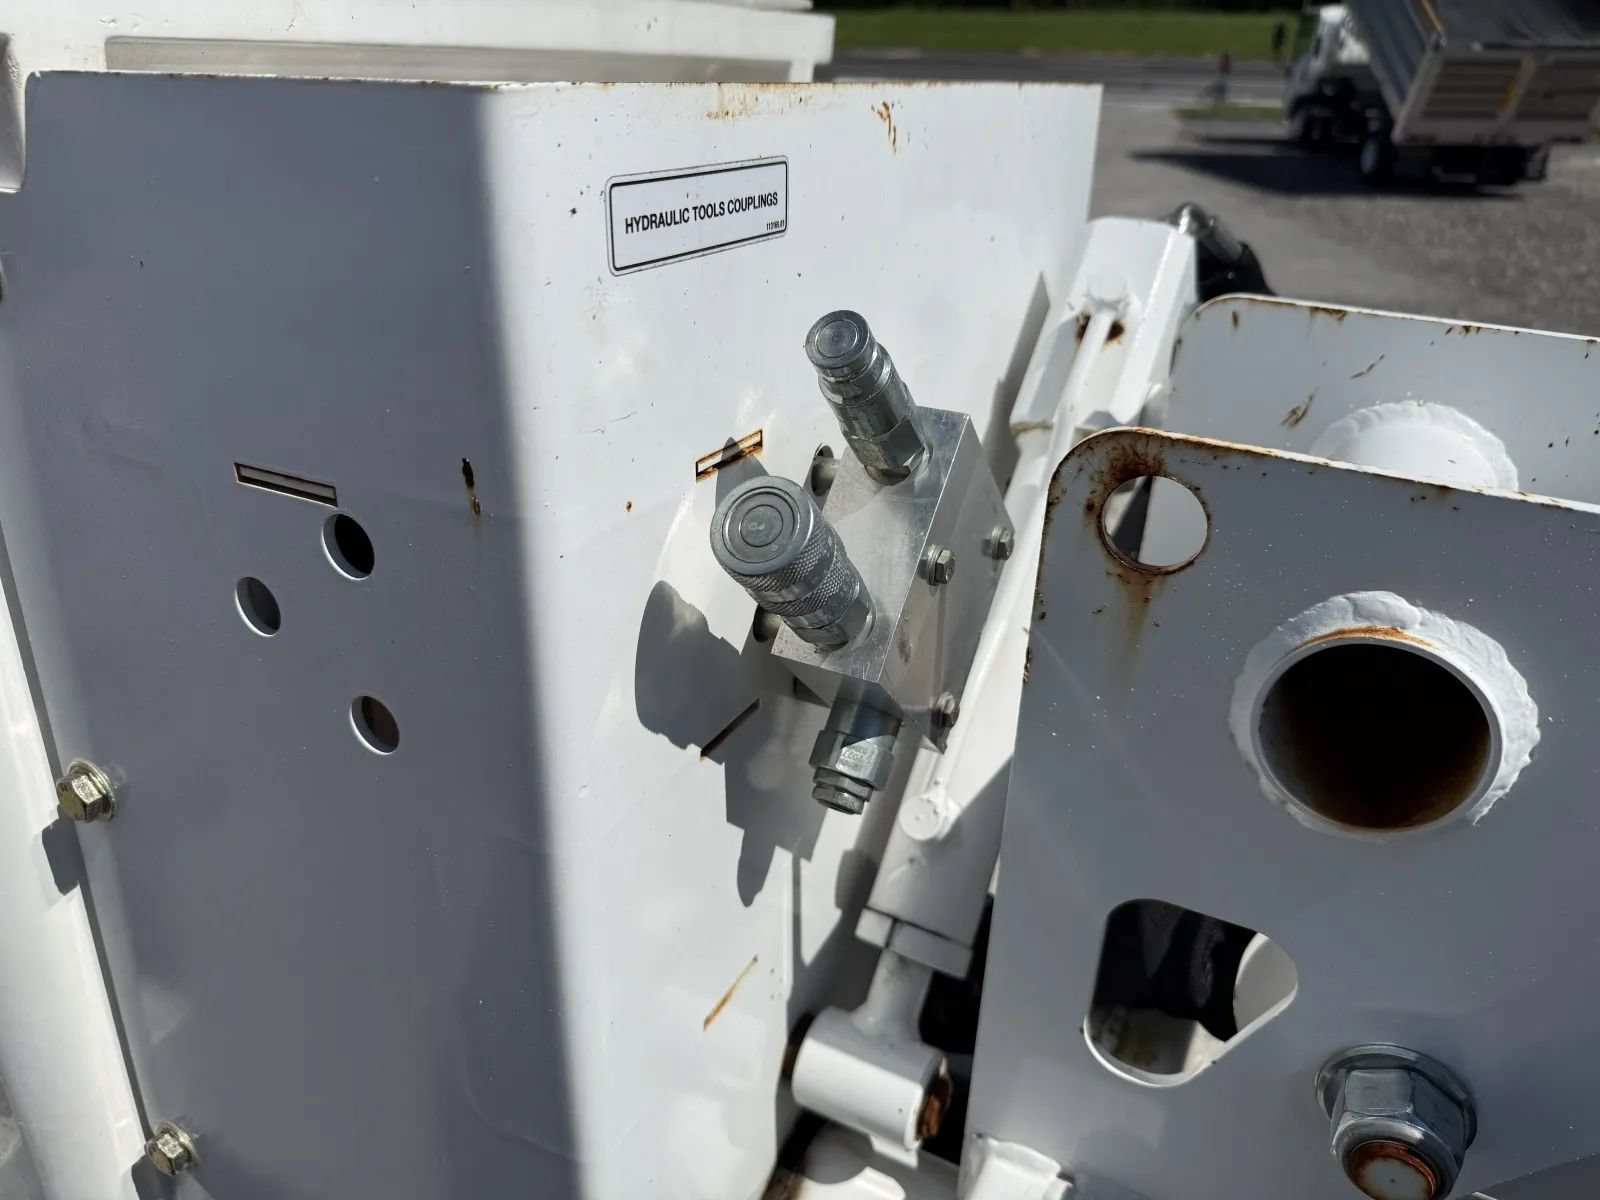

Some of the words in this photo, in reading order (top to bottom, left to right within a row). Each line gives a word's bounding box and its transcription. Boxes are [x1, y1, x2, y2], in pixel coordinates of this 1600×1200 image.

[625, 208, 690, 234] HYDRAULIC
[692, 201, 725, 221] TOOLS
[727, 192, 778, 215] COUPLINGS
